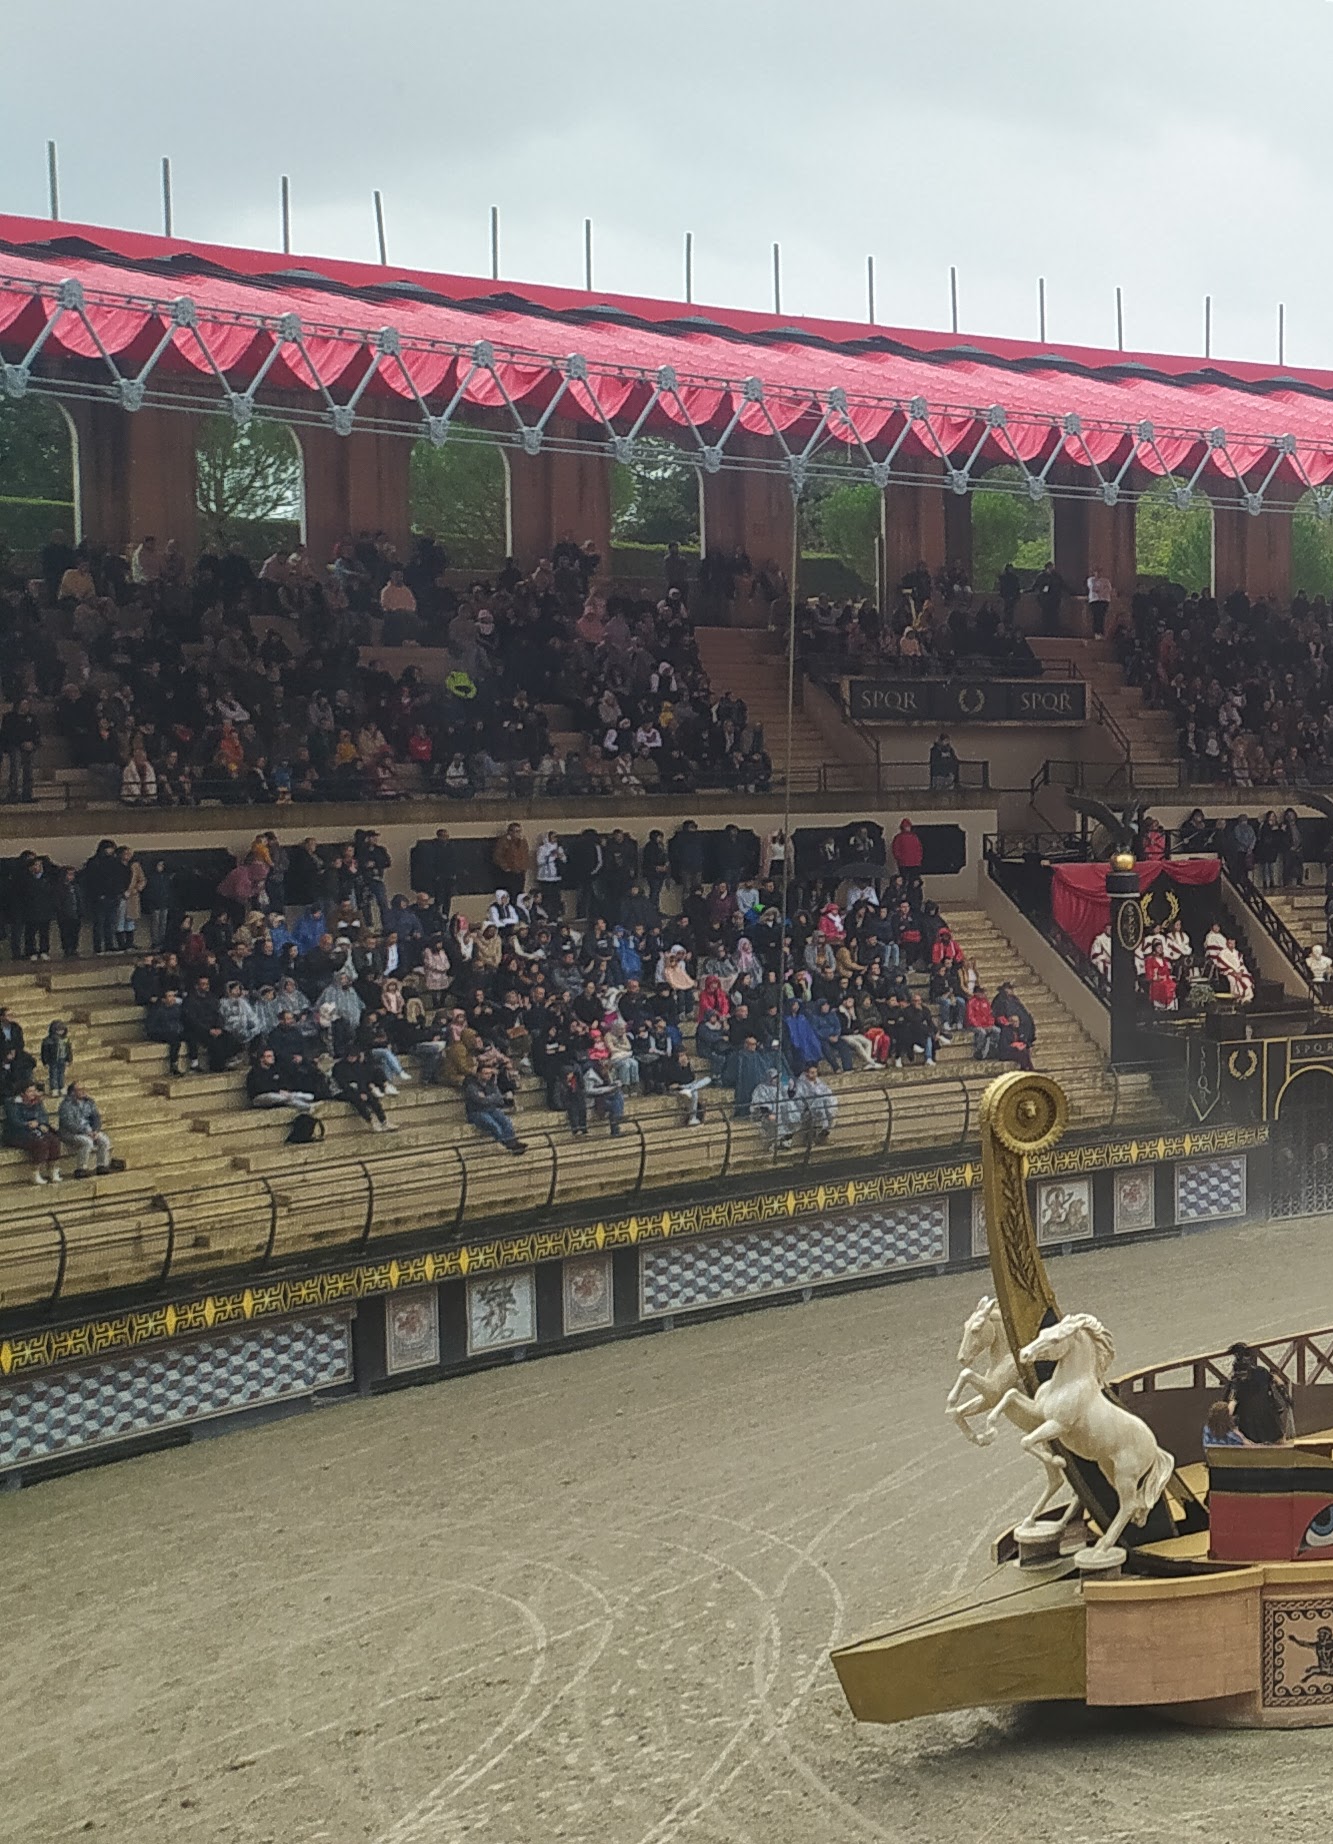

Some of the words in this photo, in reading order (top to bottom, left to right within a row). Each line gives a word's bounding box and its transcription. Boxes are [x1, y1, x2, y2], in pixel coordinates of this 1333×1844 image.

[861, 690, 917, 713] SPQR
[1020, 691, 1072, 713] SPQR
[1198, 1046, 1211, 1104] SPQR
